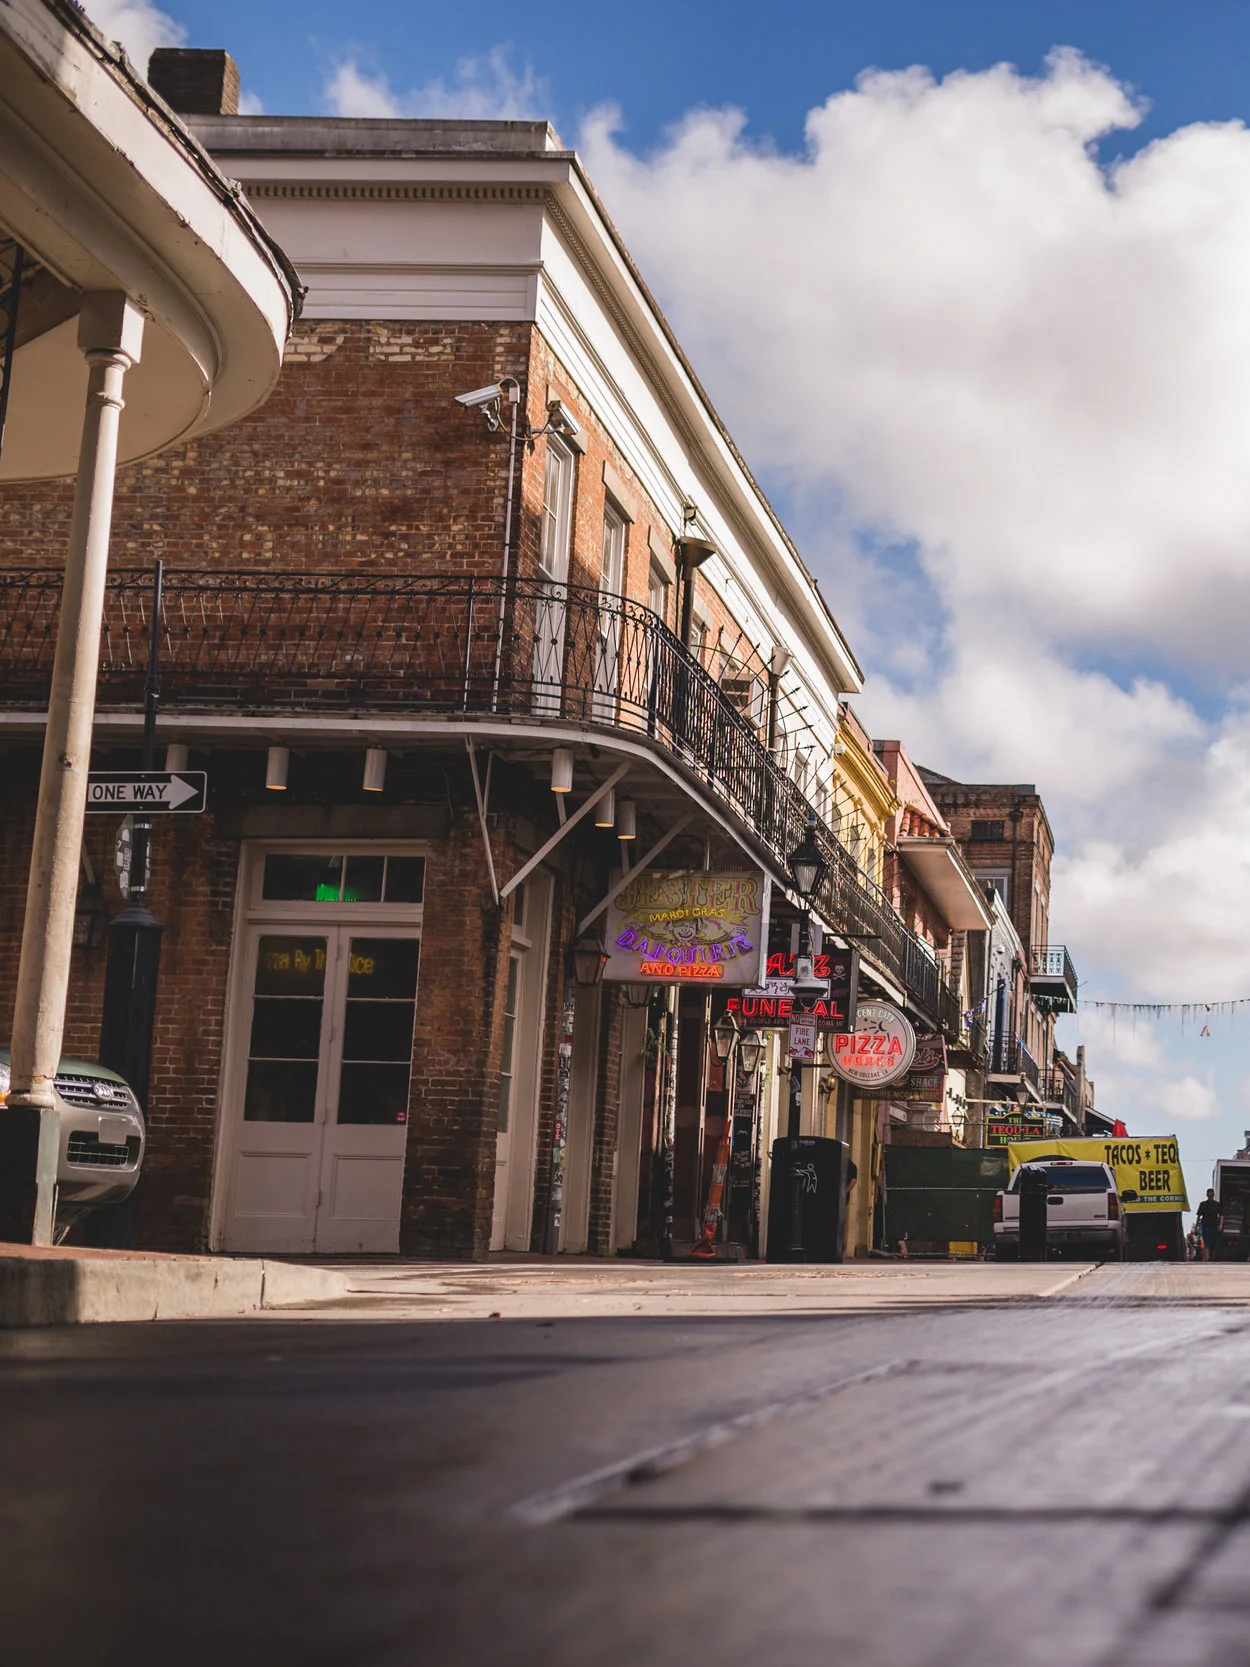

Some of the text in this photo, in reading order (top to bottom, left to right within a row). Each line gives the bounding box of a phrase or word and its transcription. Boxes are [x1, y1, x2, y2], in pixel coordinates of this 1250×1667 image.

[92, 784, 168, 801] ONE WAY
[613, 877, 760, 915] JESTER
[649, 907, 726, 922] MARDI GRAS
[640, 962, 721, 977] AND PIZZA
[727, 998, 844, 1019] FUNEAL
[878, 1009, 897, 1023] CITY
[791, 1013, 799, 1024] NO
[795, 1028, 810, 1036] FIRE
[794, 1037, 811, 1046] LANE
[835, 1034, 903, 1055] PIZZA
[842, 1056, 895, 1067] WORKS
[848, 1068, 859, 1077] NEW
[881, 1068, 889, 1076] LA
[991, 1125, 1040, 1136] TEQULA
[1104, 1144, 1141, 1166] TACOS
[1139, 1170, 1171, 1192] BEER
